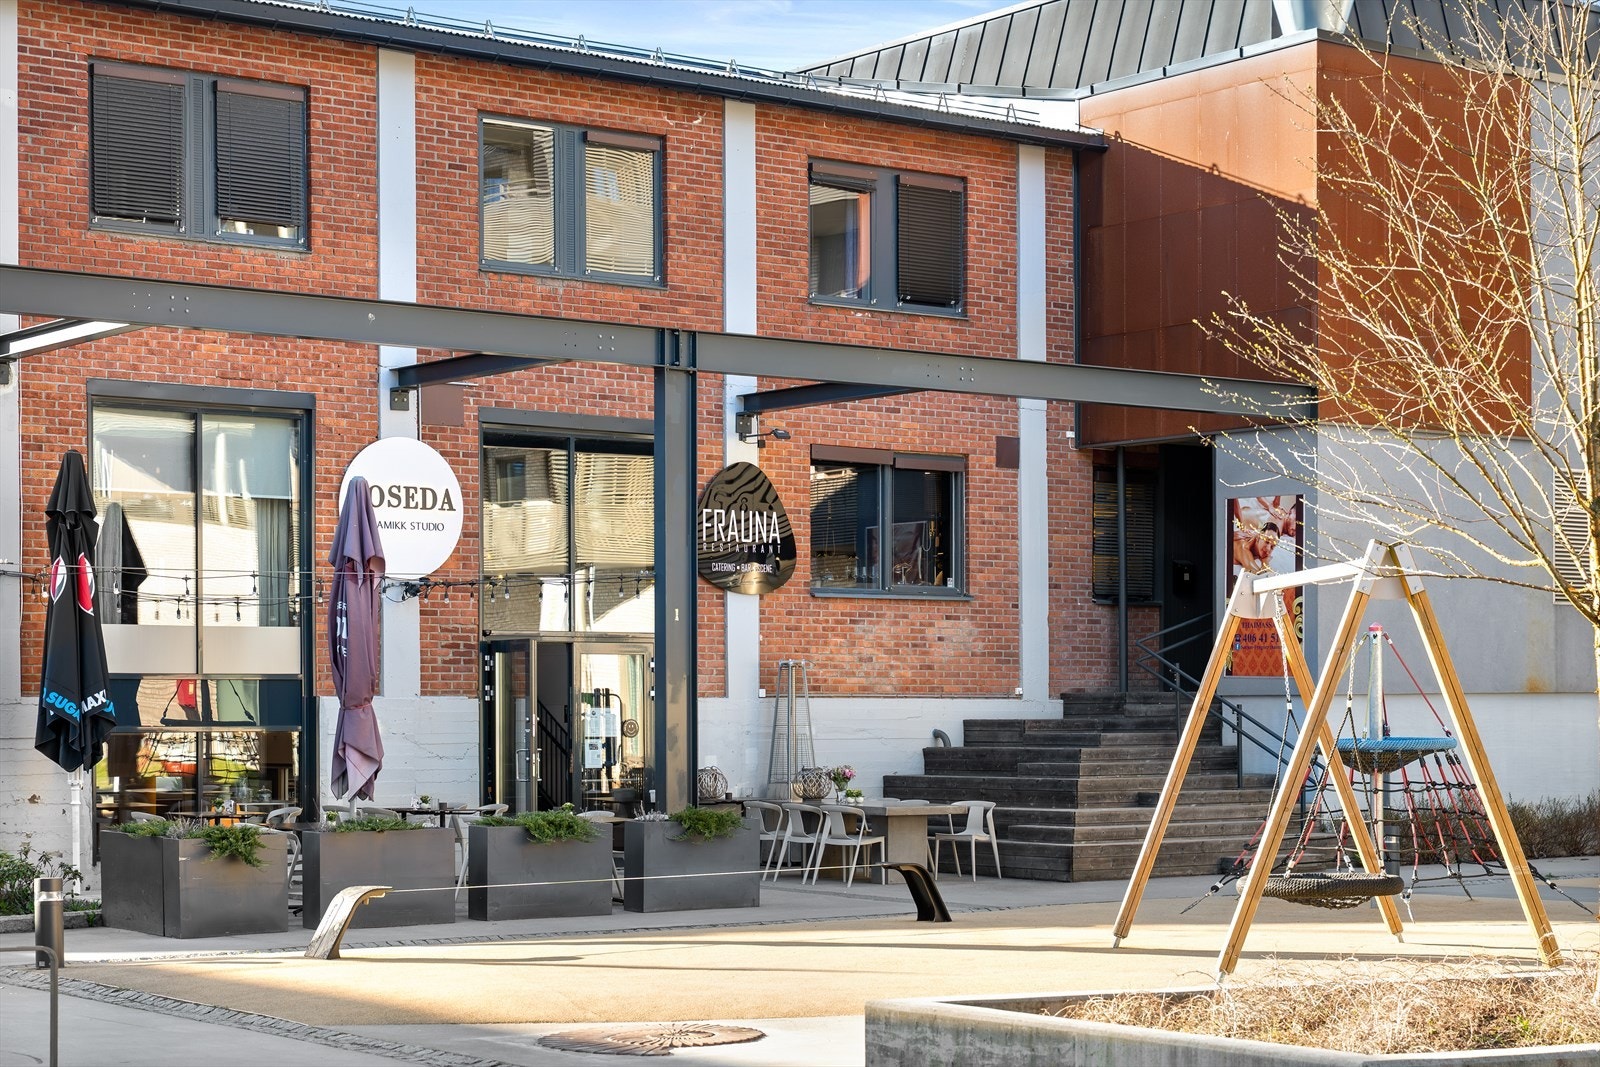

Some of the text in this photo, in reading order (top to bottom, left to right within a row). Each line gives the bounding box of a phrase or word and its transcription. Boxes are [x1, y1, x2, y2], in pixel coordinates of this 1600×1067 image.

[369, 485, 456, 511] OSEDA
[377, 520, 445, 532] AMIKK STUDIO
[702, 508, 781, 544] FRAUNA
[703, 543, 780, 553] RESTAURANT
[711, 562, 736, 572] CATERING
[741, 563, 752, 573] BAR
[1270, 633, 1280, 643] 51
[46, 692, 80, 722] SUGA
